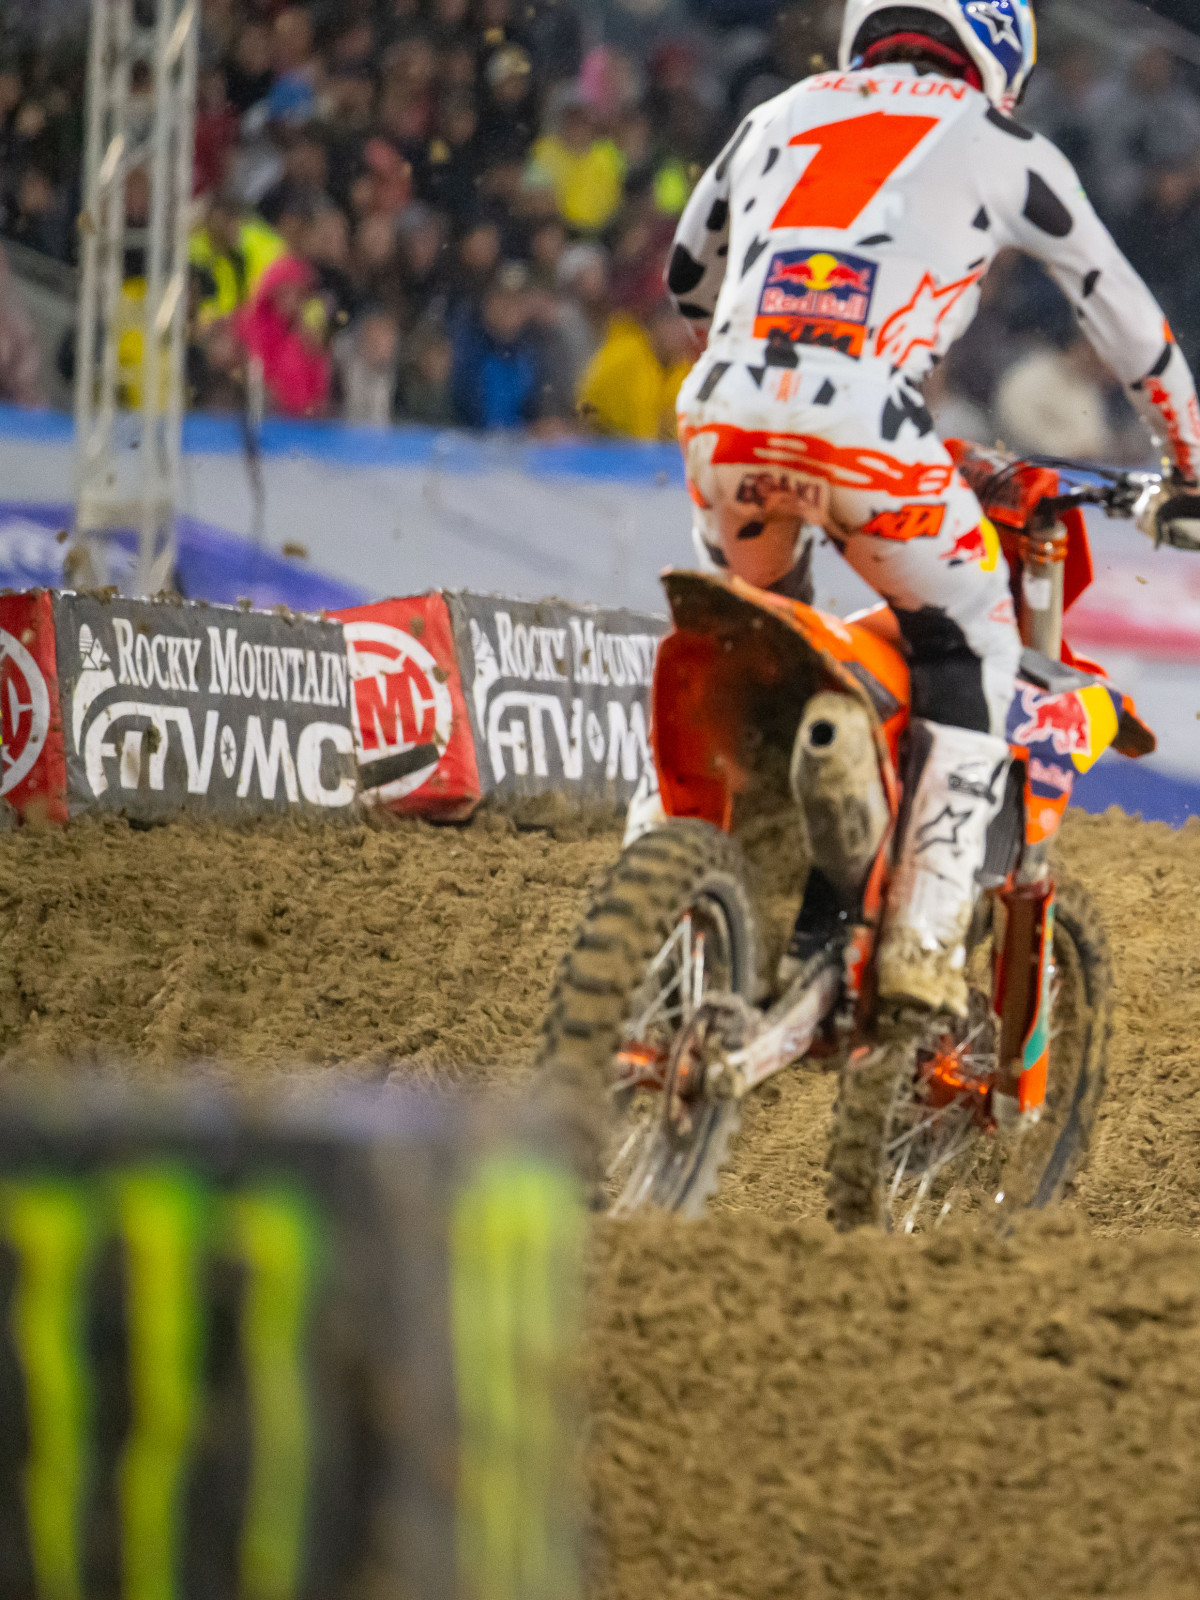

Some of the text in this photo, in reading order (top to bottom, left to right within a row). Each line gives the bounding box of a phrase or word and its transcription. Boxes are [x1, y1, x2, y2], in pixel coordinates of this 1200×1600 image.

[808, 76, 967, 100] SEXTON
[771, 110, 941, 230] 1
[112, 617, 349, 707] ROCKY MOUNTAIN
[494, 611, 659, 687] ROCKY MOUNT
[85, 701, 219, 798] ATV
[353, 668, 415, 751] M
[488, 690, 652, 784] ATV M
